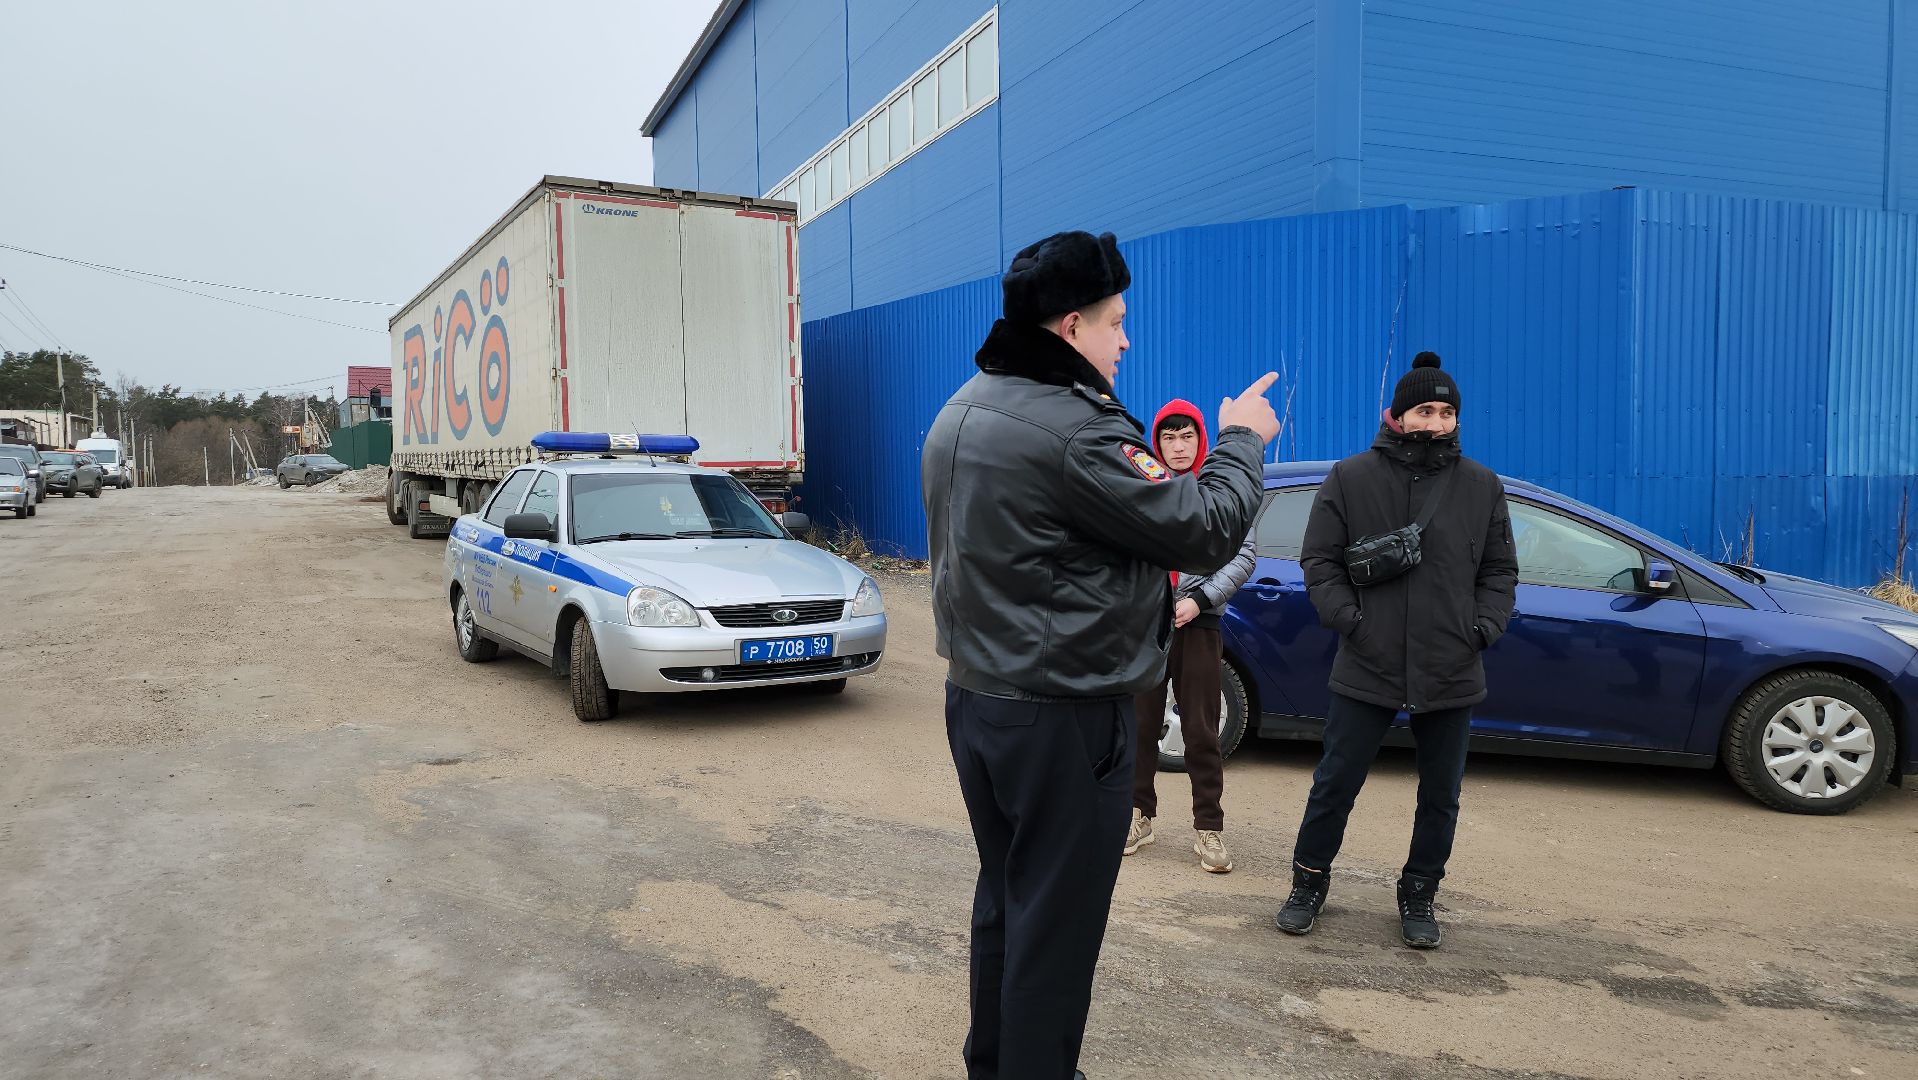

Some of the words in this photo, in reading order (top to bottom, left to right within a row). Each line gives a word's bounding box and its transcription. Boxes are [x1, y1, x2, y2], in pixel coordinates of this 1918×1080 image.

[596, 207, 639, 217] KRONE
[514, 544, 541, 563] ПОЛИЦИЯ
[476, 586, 492, 615] 112
[766, 640, 805, 658] 7708
[813, 636, 828, 649] 50
